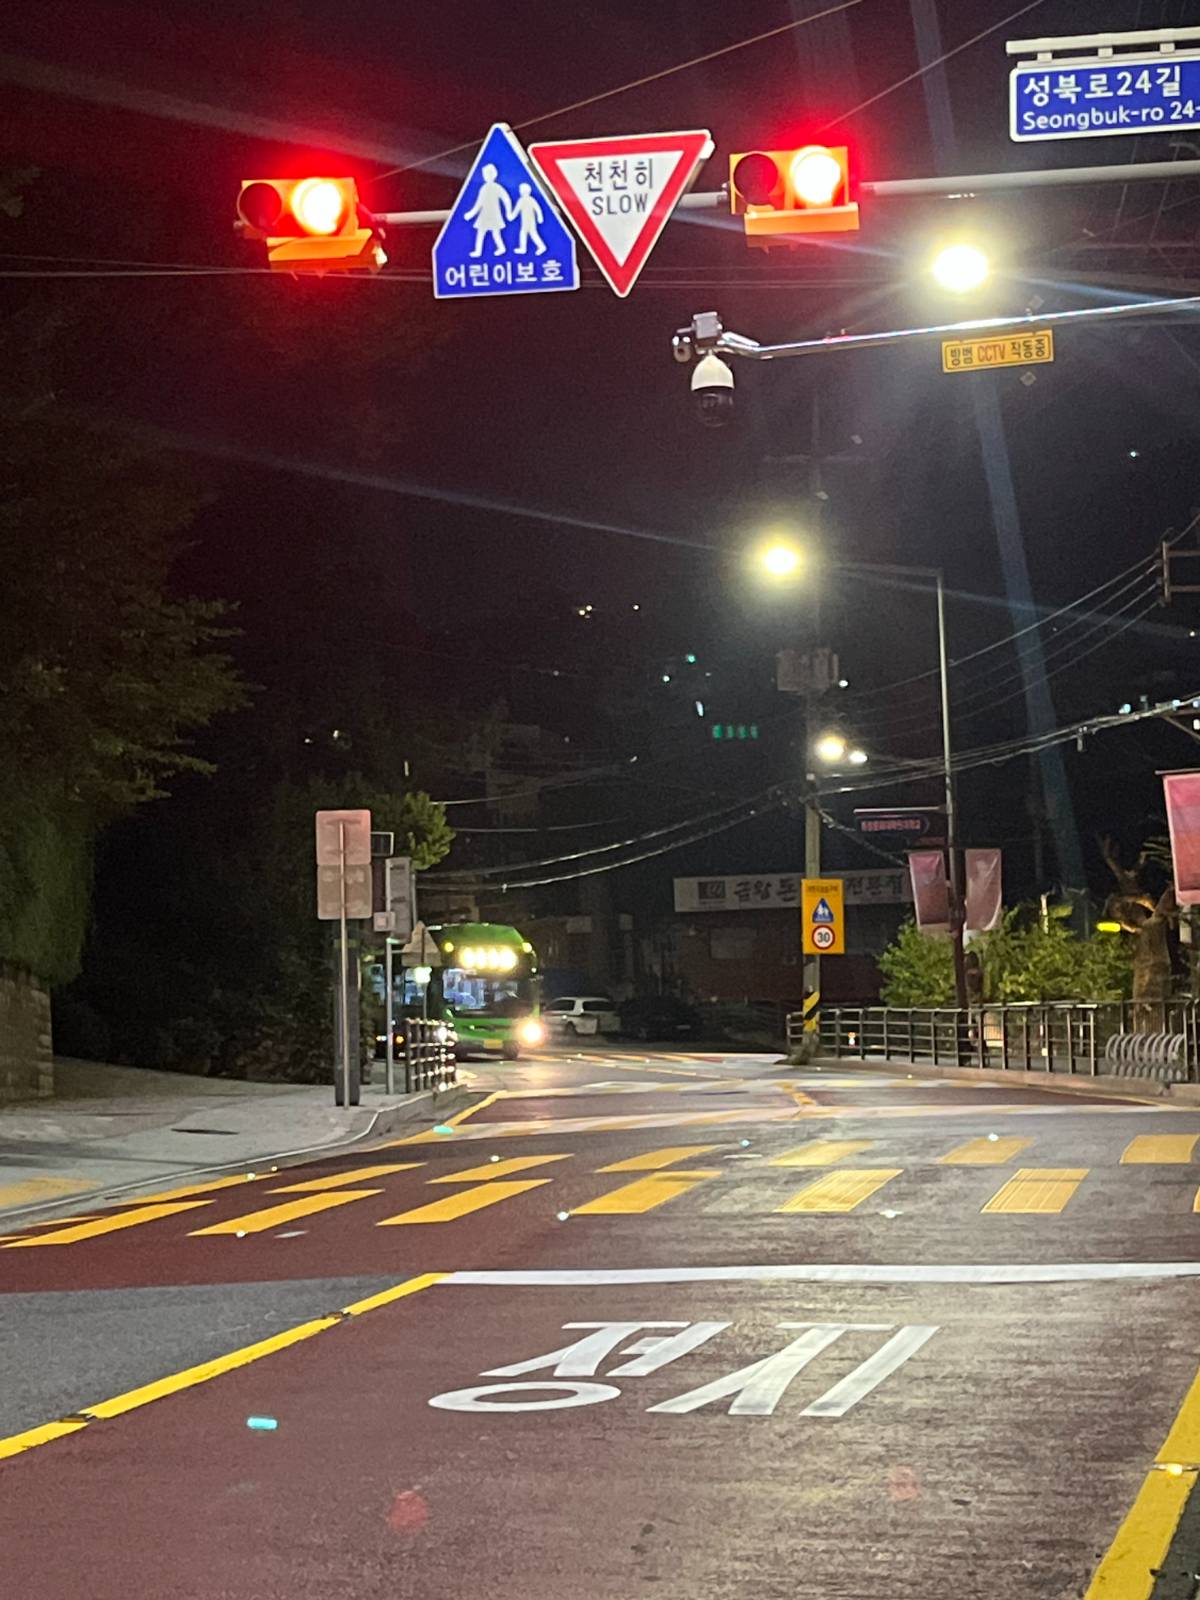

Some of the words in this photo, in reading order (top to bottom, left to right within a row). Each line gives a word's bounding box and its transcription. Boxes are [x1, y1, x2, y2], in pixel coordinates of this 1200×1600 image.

[1023, 65, 1181, 107] 성북로24길
[1022, 104, 1164, 130] Seongbuk-ro
[584, 158, 653, 192] 천천히
[592, 192, 648, 216] SLOW
[445, 259, 564, 288] 어린이보호
[950, 347, 973, 367] 방범
[977, 343, 1006, 363] CCTV
[1010, 338, 1046, 360] 작동중
[817, 931, 831, 943] 30
[428, 1321, 941, 1417] 정지
